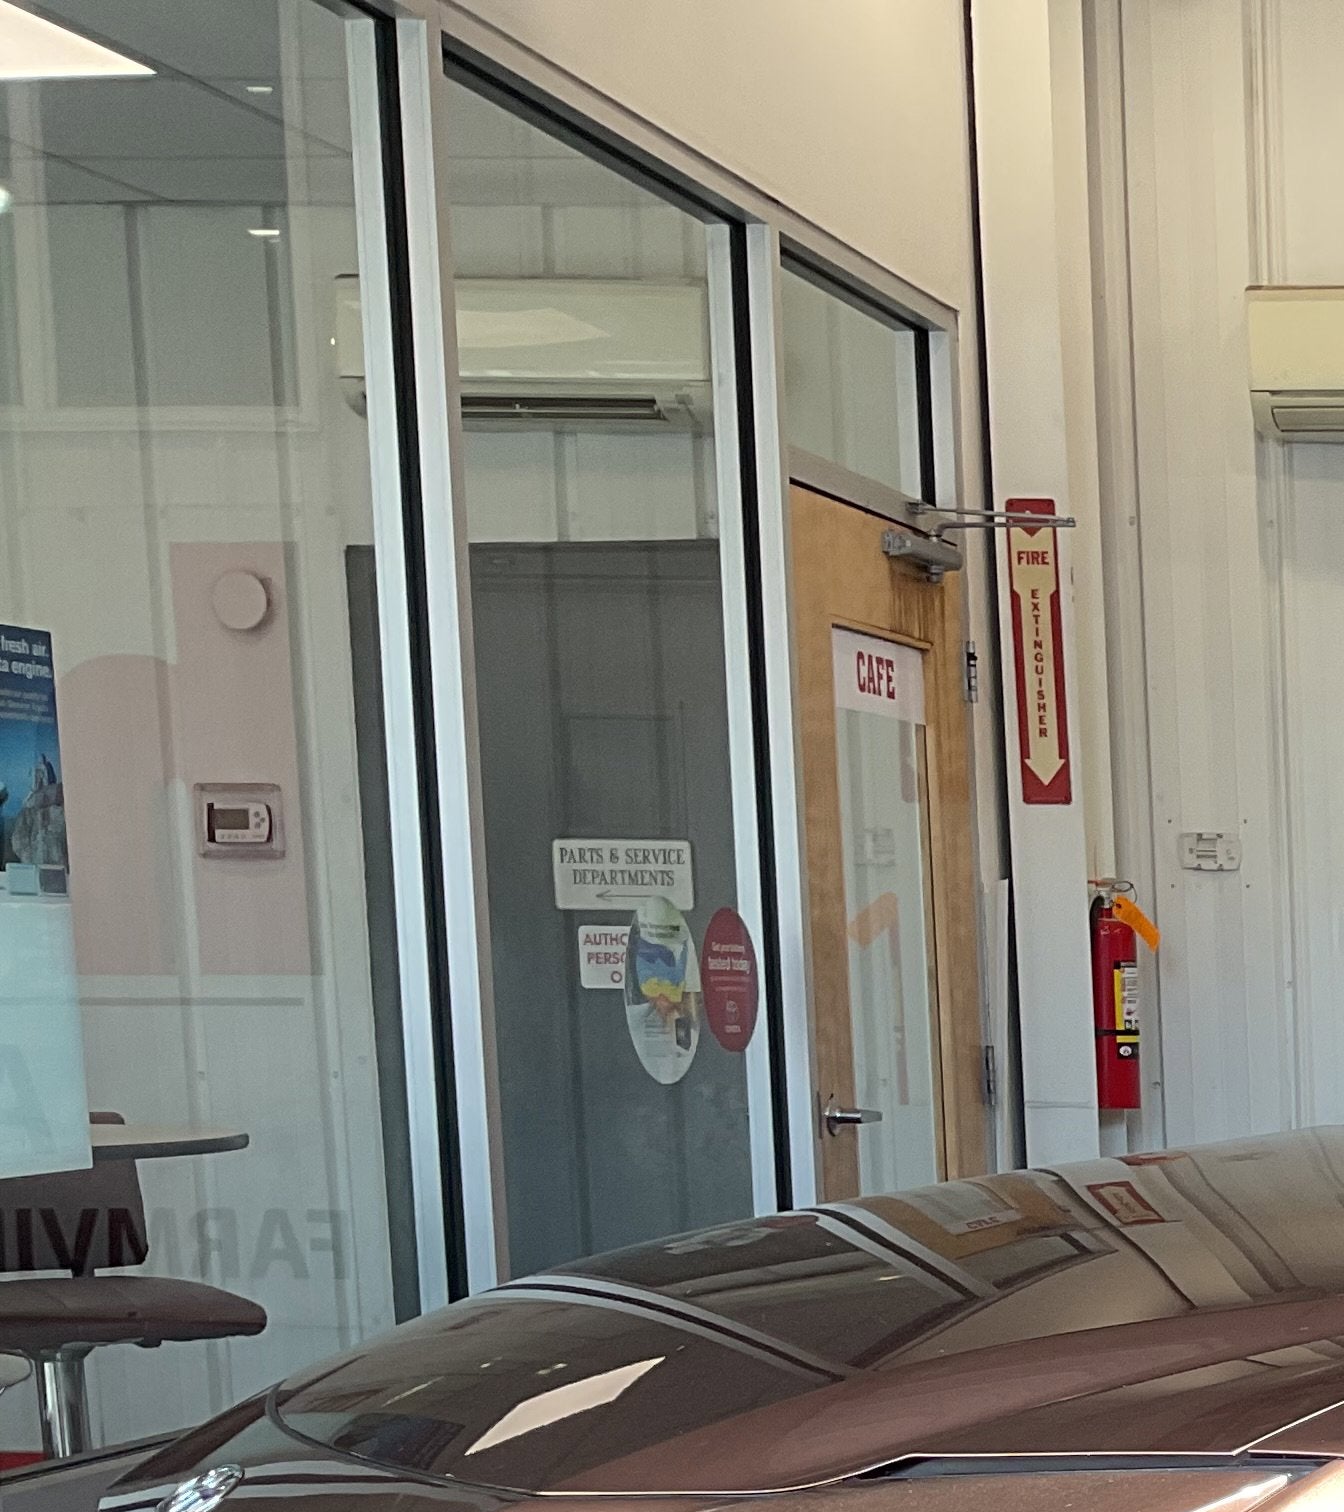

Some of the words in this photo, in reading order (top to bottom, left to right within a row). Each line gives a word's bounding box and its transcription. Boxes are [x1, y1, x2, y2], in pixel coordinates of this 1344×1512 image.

[1017, 551, 1050, 565] FIRE
[1031, 589, 1048, 737] EXTINGUISHER
[856, 650, 895, 700] CAFE
[559, 848, 603, 864] PARTS
[610, 848, 619, 864] &
[625, 849, 685, 865] SERVICE
[573, 869, 675, 886] DEPARTMENTS
[583, 933, 628, 946] AUTHO
